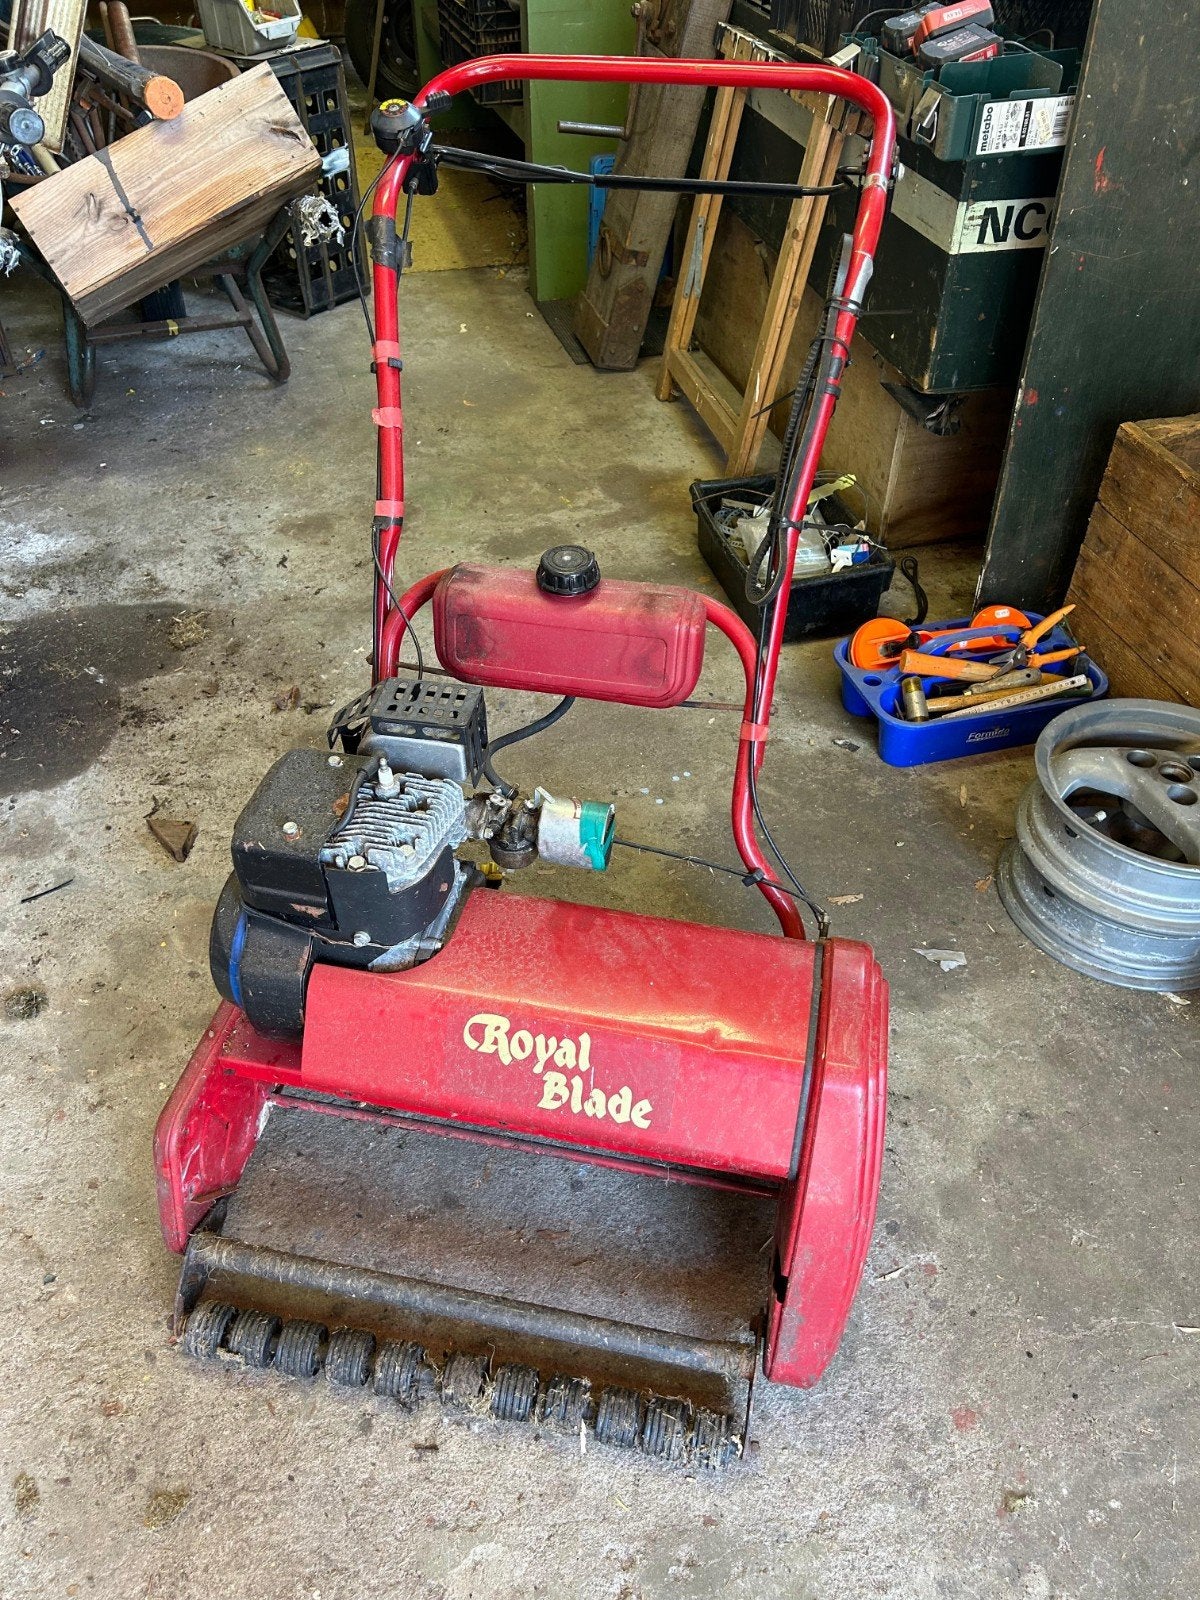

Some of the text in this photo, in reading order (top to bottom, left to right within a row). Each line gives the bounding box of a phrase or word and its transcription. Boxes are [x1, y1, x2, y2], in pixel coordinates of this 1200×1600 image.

[980, 106, 994, 152] metabo
[977, 202, 1054, 245] NC
[463, 1013, 591, 1074] Royal
[537, 1071, 653, 1129] Blade
